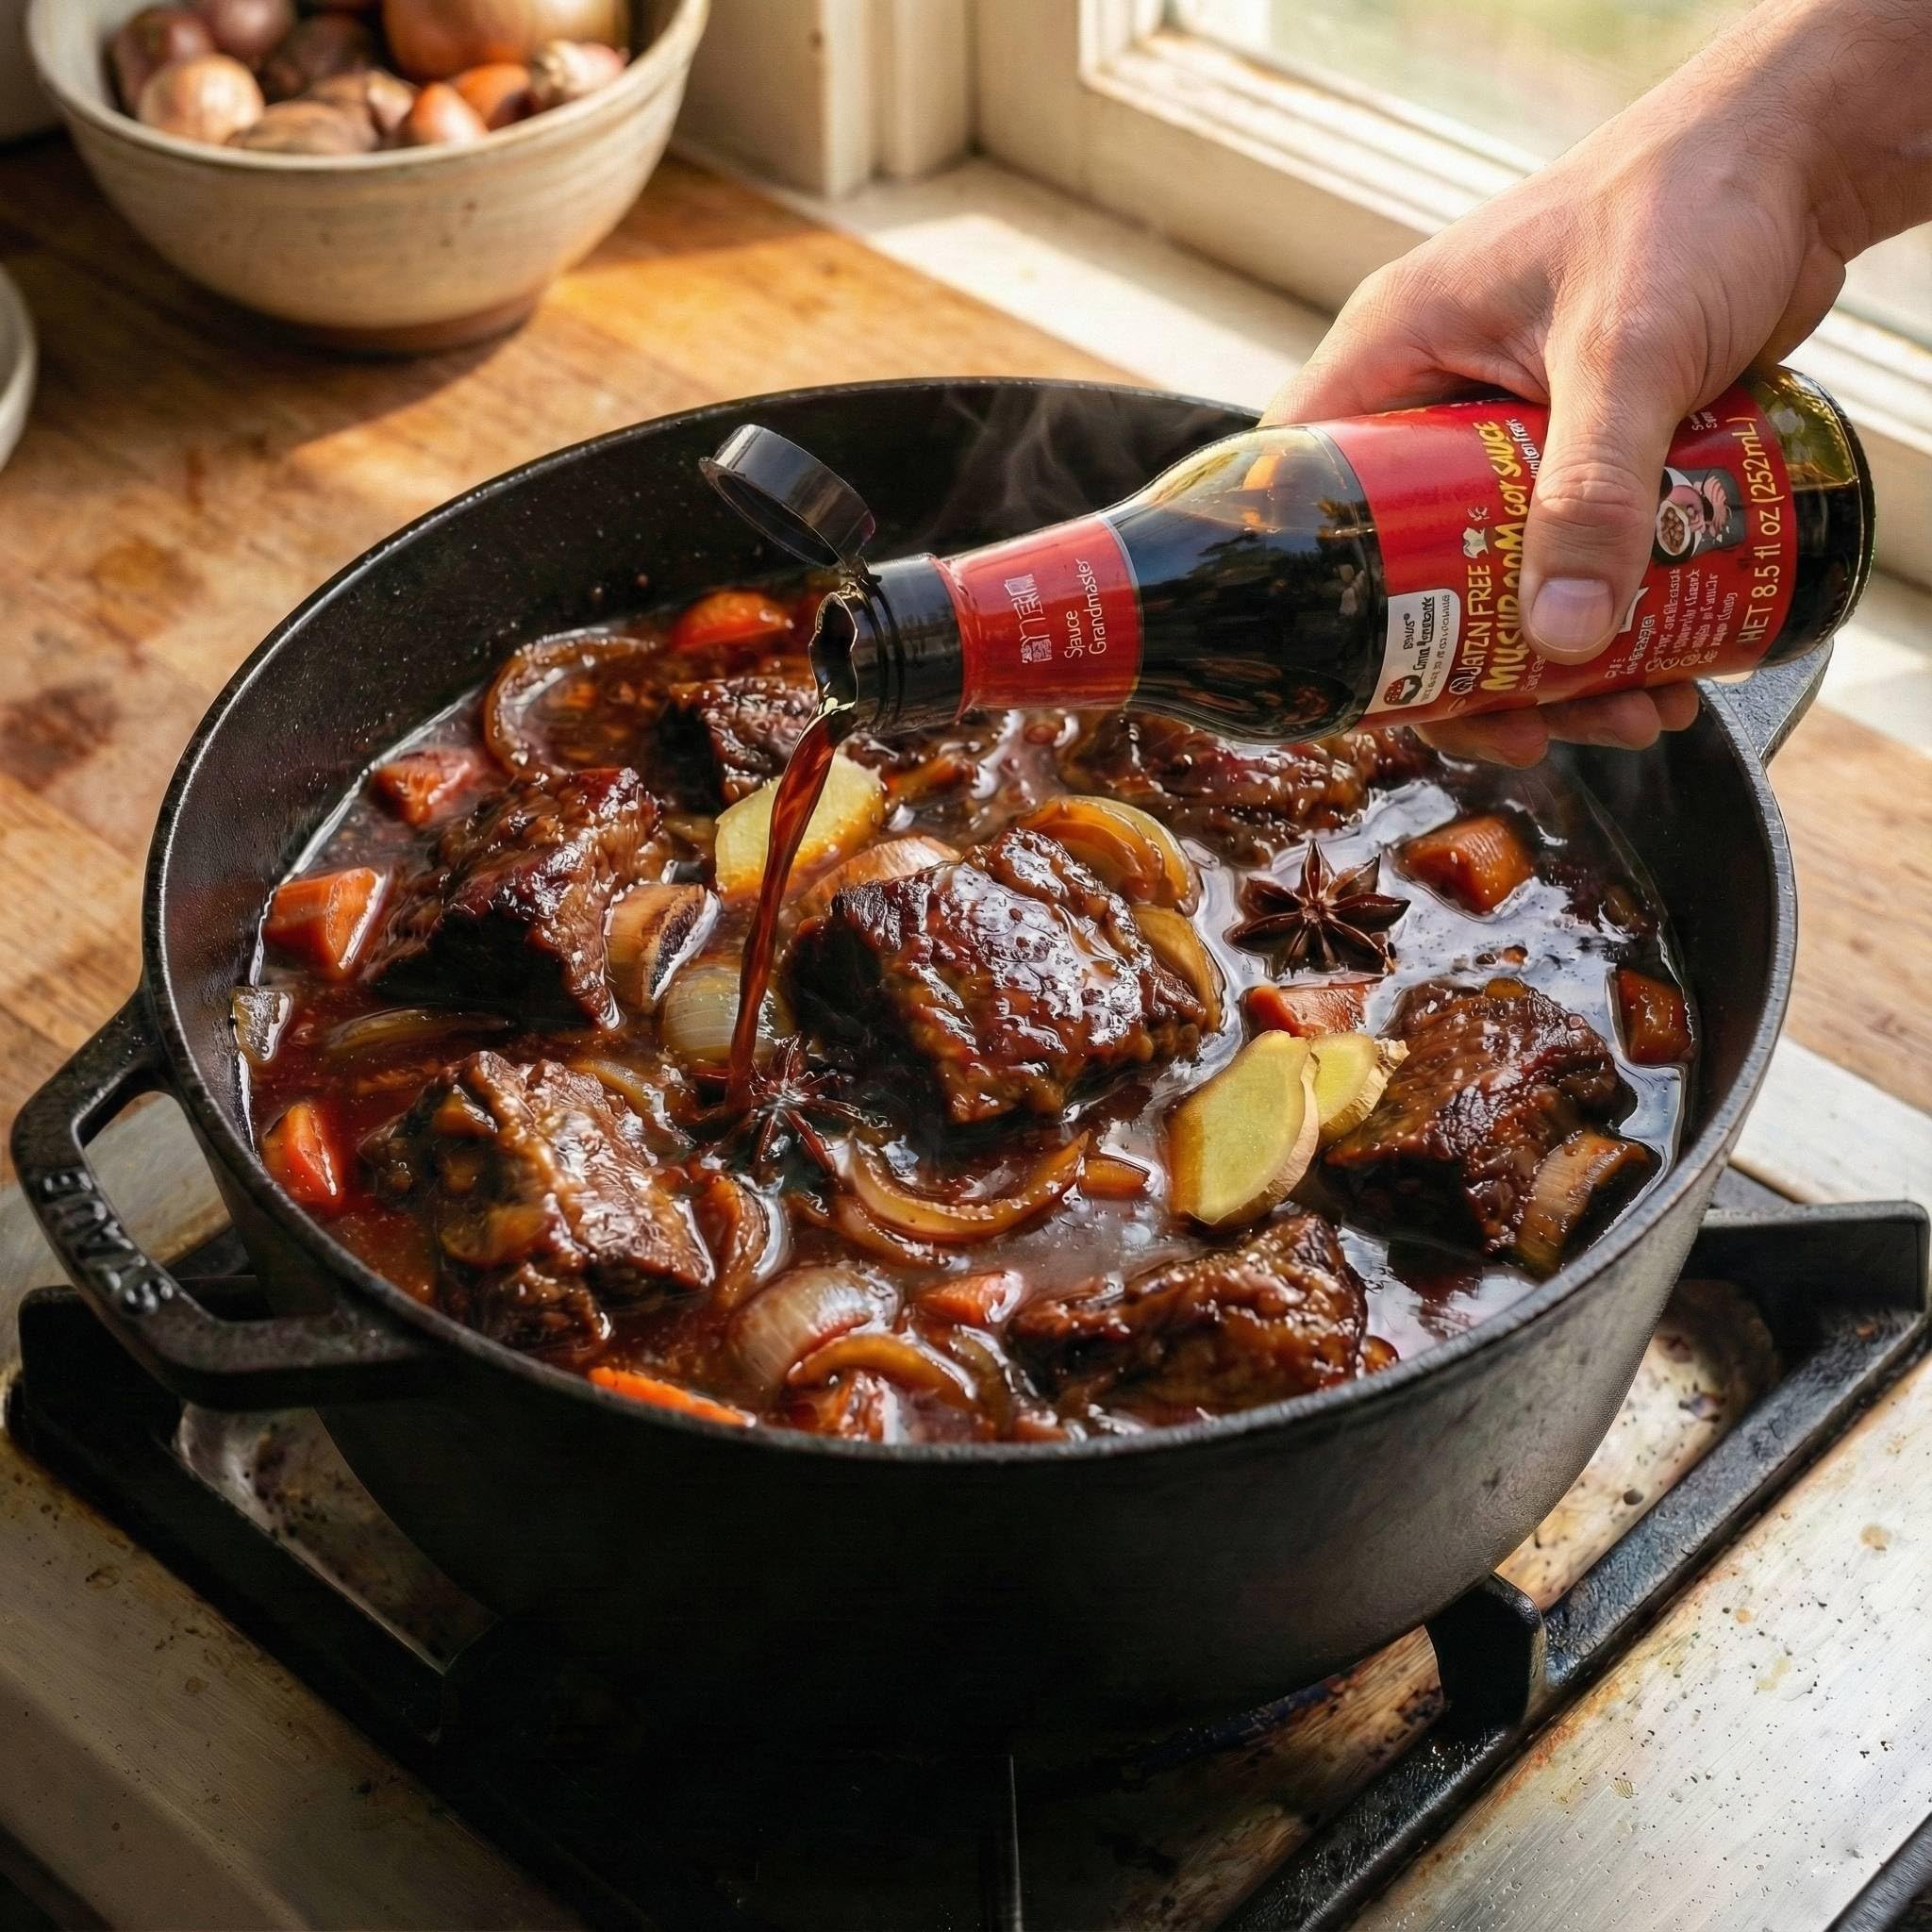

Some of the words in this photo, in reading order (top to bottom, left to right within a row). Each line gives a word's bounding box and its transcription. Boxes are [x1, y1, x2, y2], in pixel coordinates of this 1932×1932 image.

[1473, 421, 1522, 477] SAUCE
[1725, 417, 1785, 503] (252mL)
[1759, 507, 1781, 536] oz
[1075, 558, 1107, 655] Grandmaster
[1467, 564, 1495, 616] FREE
[1751, 565, 1780, 598] 8.5
[1064, 610, 1086, 658] Sauce
